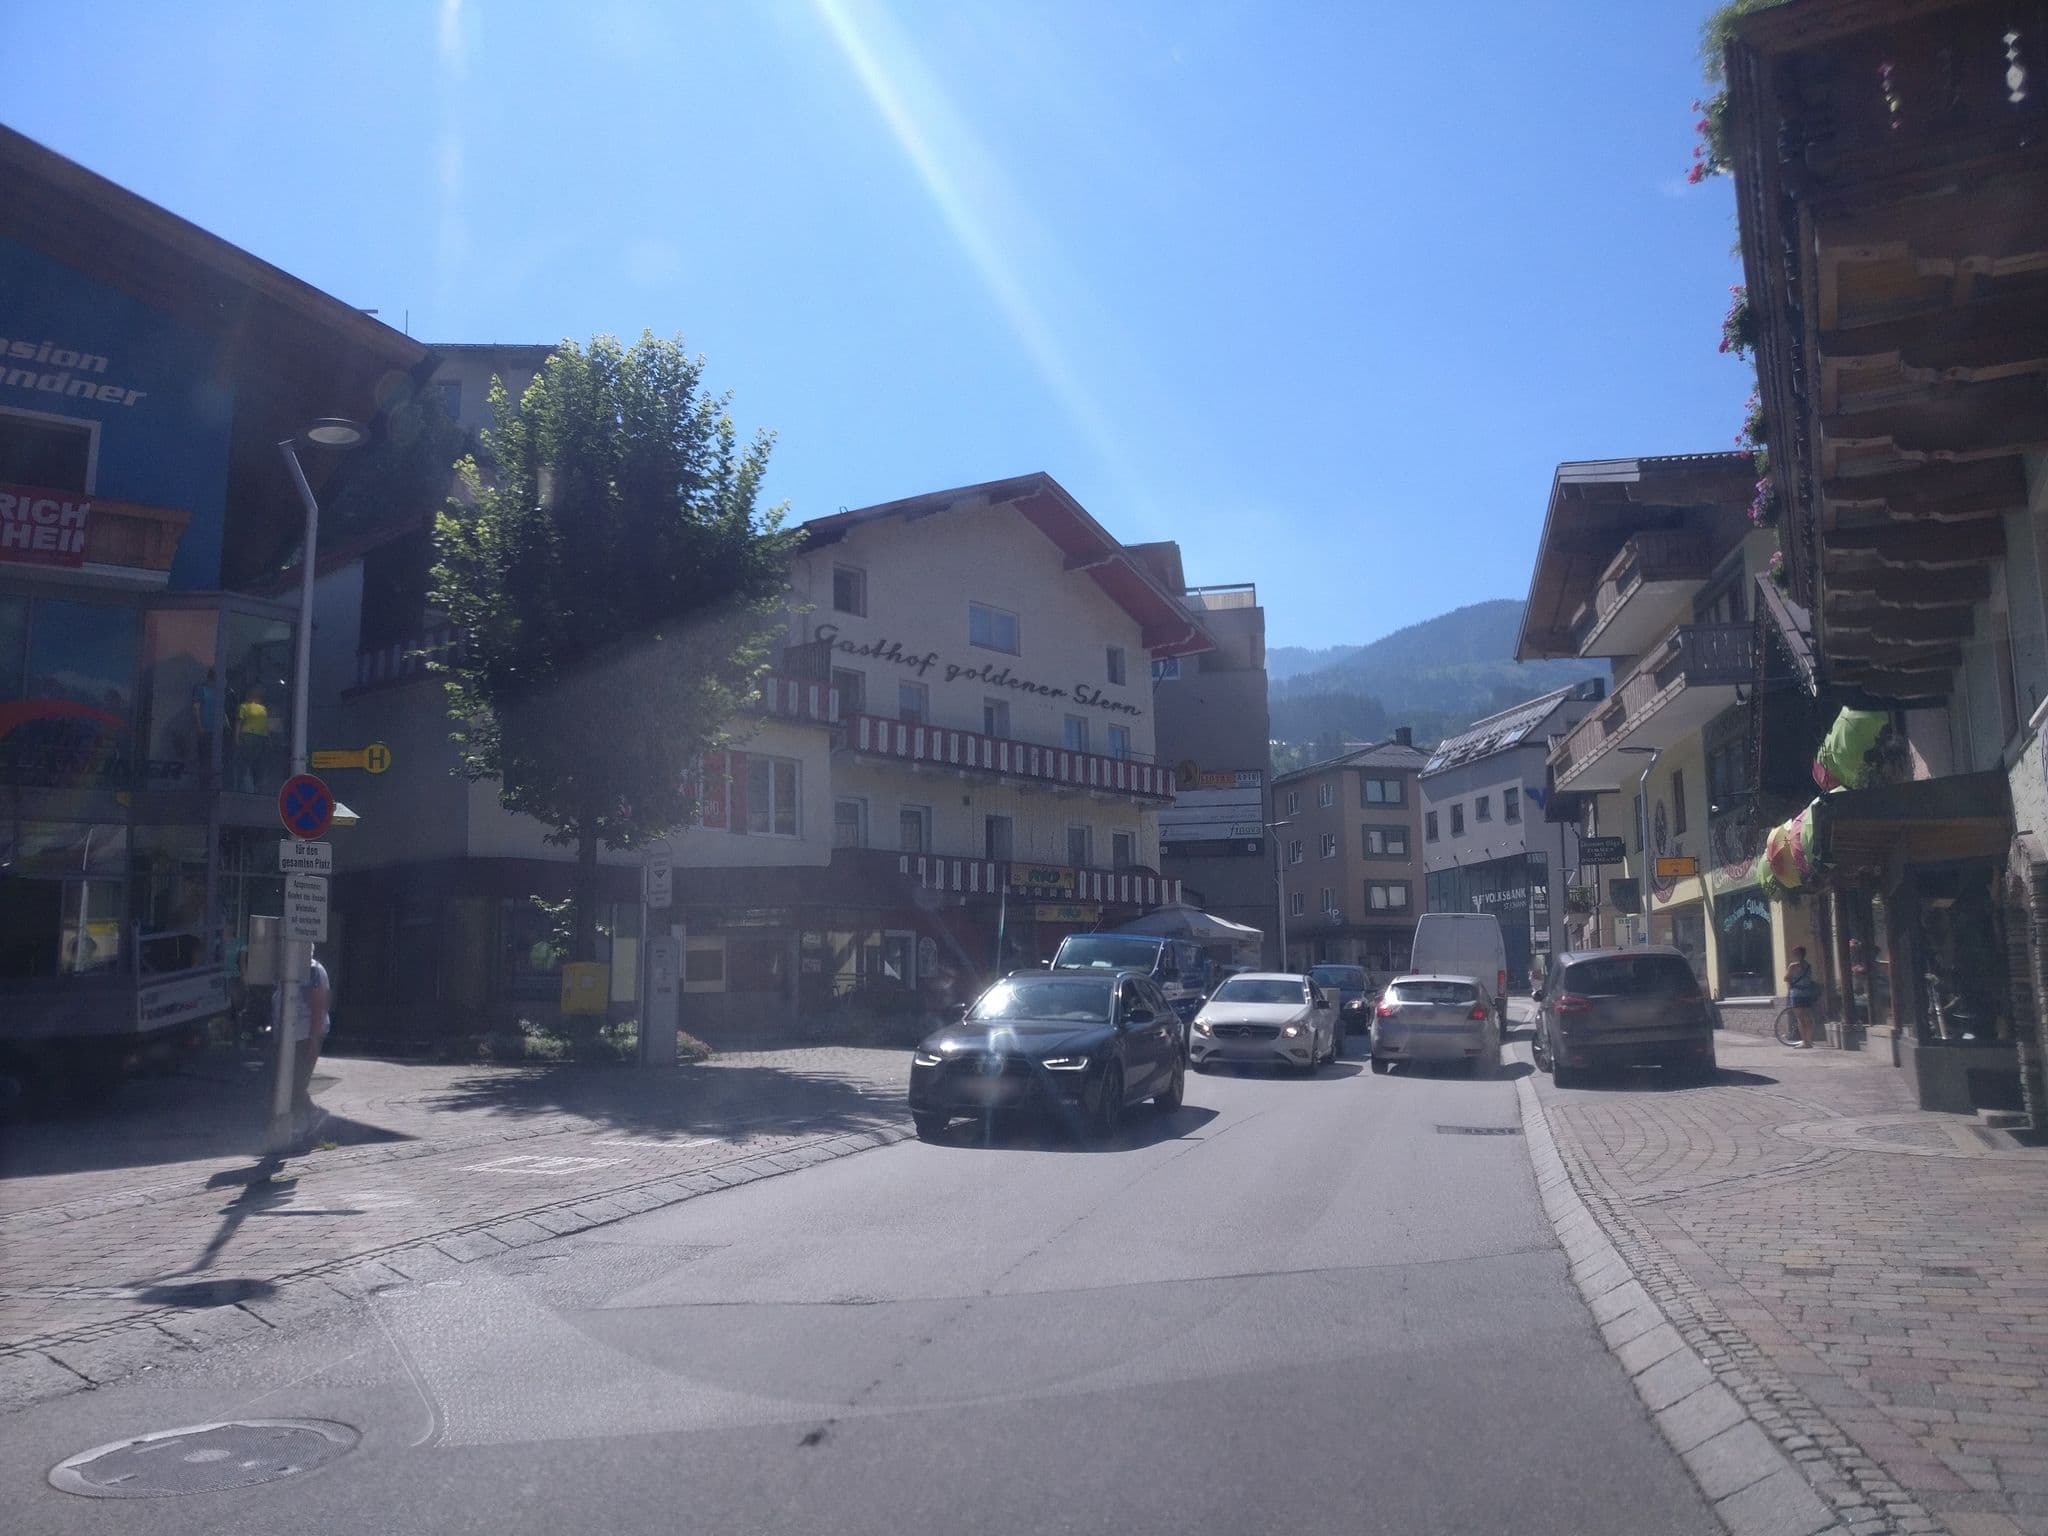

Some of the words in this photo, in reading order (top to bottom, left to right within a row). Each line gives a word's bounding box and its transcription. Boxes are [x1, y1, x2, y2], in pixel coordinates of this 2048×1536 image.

[0, 365, 148, 407] ndner
[814, 622, 936, 677] Gasthof
[943, 662, 1068, 698] goldener
[1072, 682, 1143, 717] Stern
